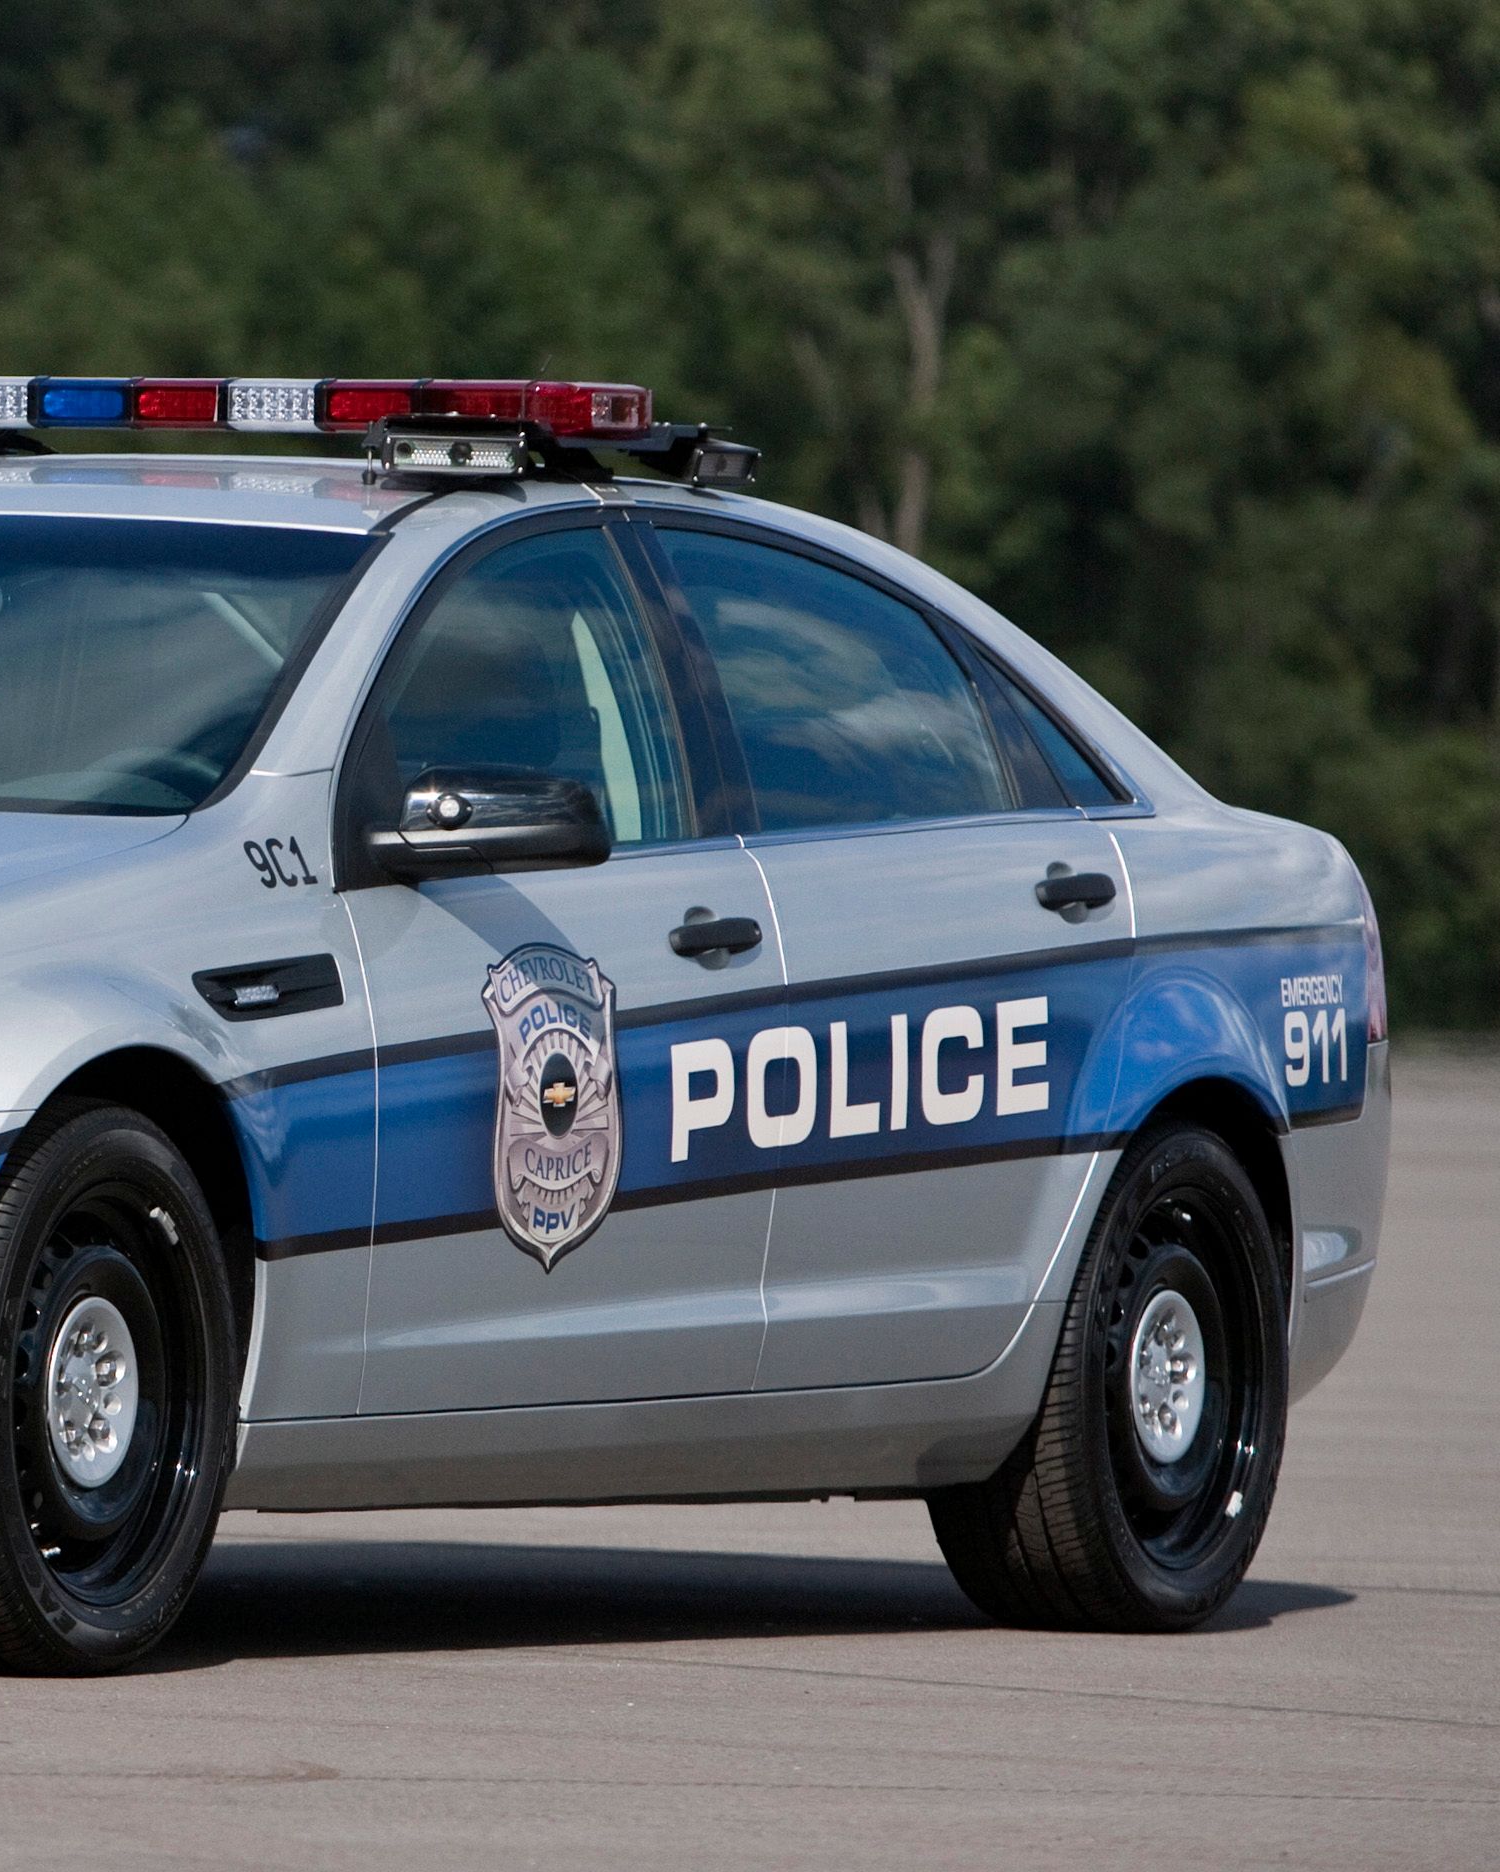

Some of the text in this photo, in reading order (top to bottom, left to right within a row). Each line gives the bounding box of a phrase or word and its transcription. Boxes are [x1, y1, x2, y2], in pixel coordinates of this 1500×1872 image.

[243, 836, 319, 888] 9C1
[500, 956, 596, 1003] CHEVROLET
[1280, 974, 1343, 1008] EMERGENCY
[518, 1001, 593, 1045] POLICE
[1284, 1008, 1348, 1087] 911
[671, 996, 1050, 1163] POLICE
[524, 1143, 592, 1181] CAPRICE
[532, 1203, 577, 1234] PPV
